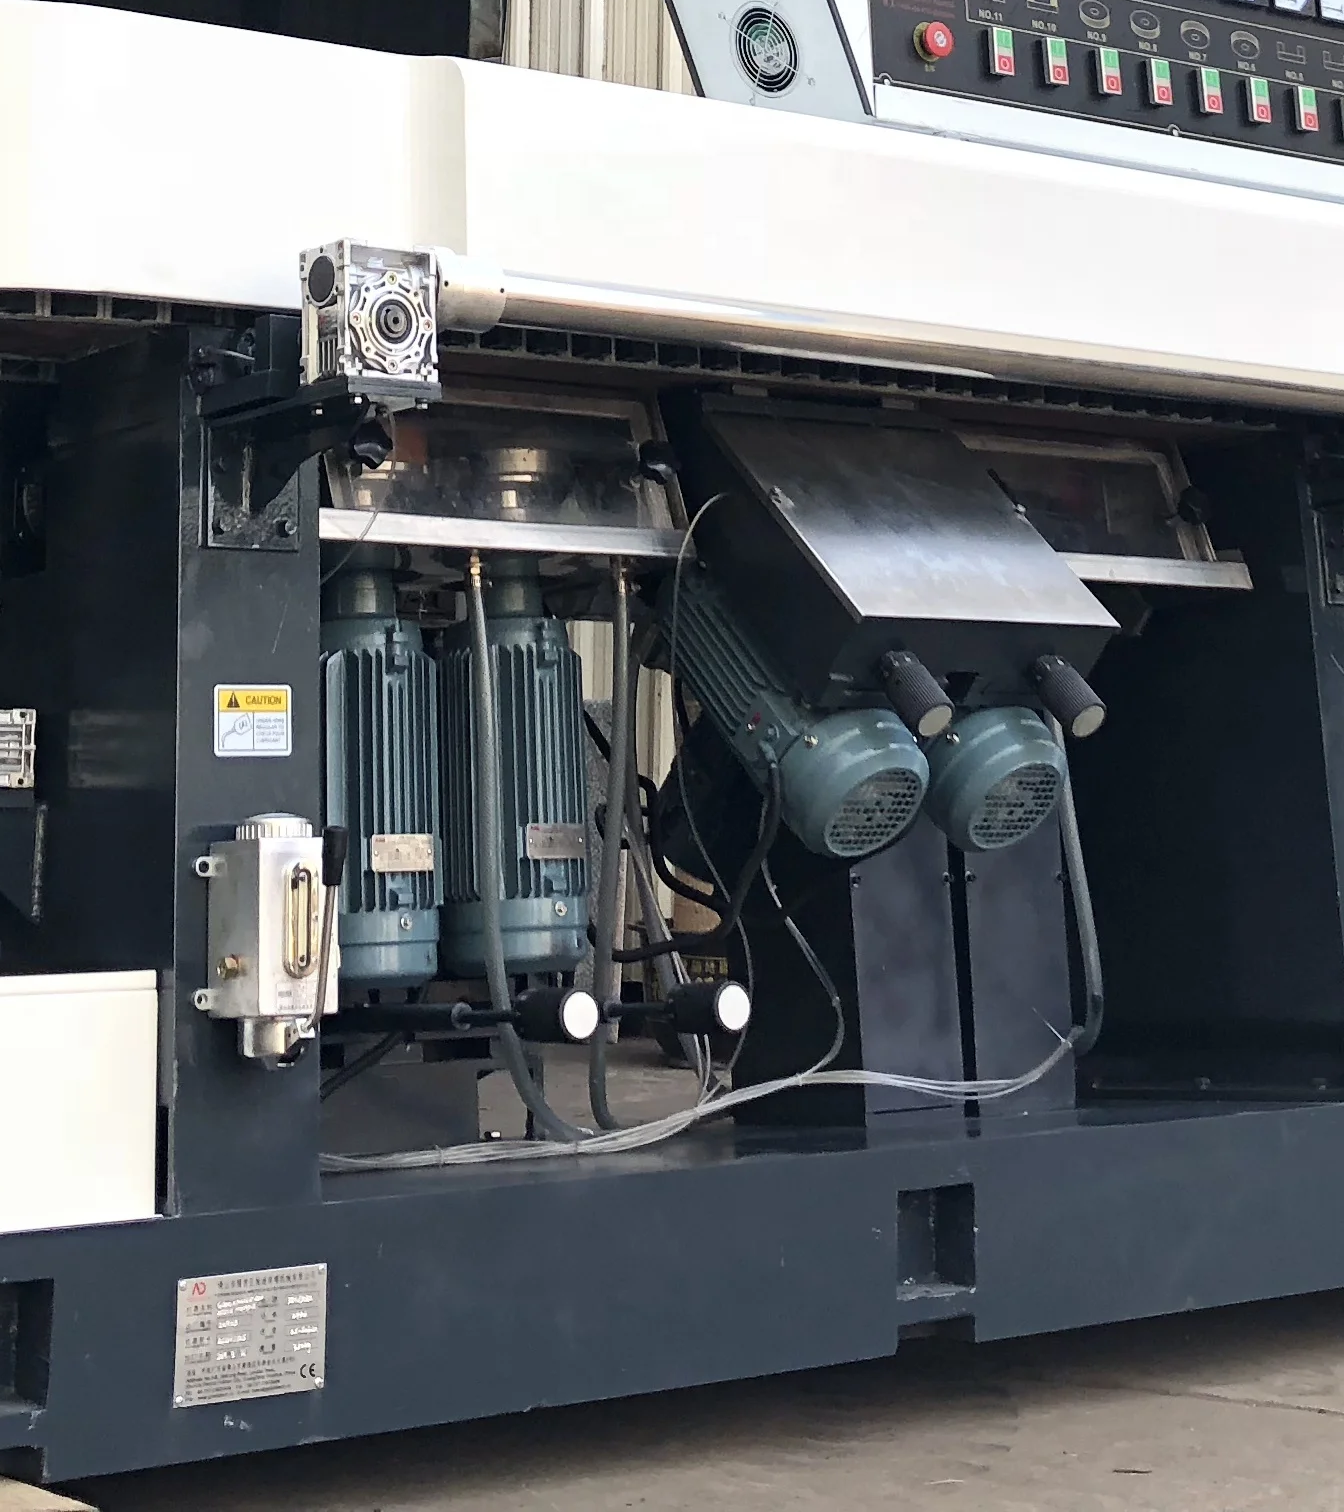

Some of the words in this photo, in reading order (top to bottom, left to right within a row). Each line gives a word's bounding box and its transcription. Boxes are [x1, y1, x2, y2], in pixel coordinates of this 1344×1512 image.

[978, 7, 1004, 22] NO.11
[1031, 19, 1057, 33] NO.10
[1086, 30, 1107, 43] NO.9
[1138, 40, 1158, 53] NO.8
[1188, 50, 1208, 63] NO.7
[245, 695, 282, 705] CAUTION
[299, 1362, 317, 1379] CE
